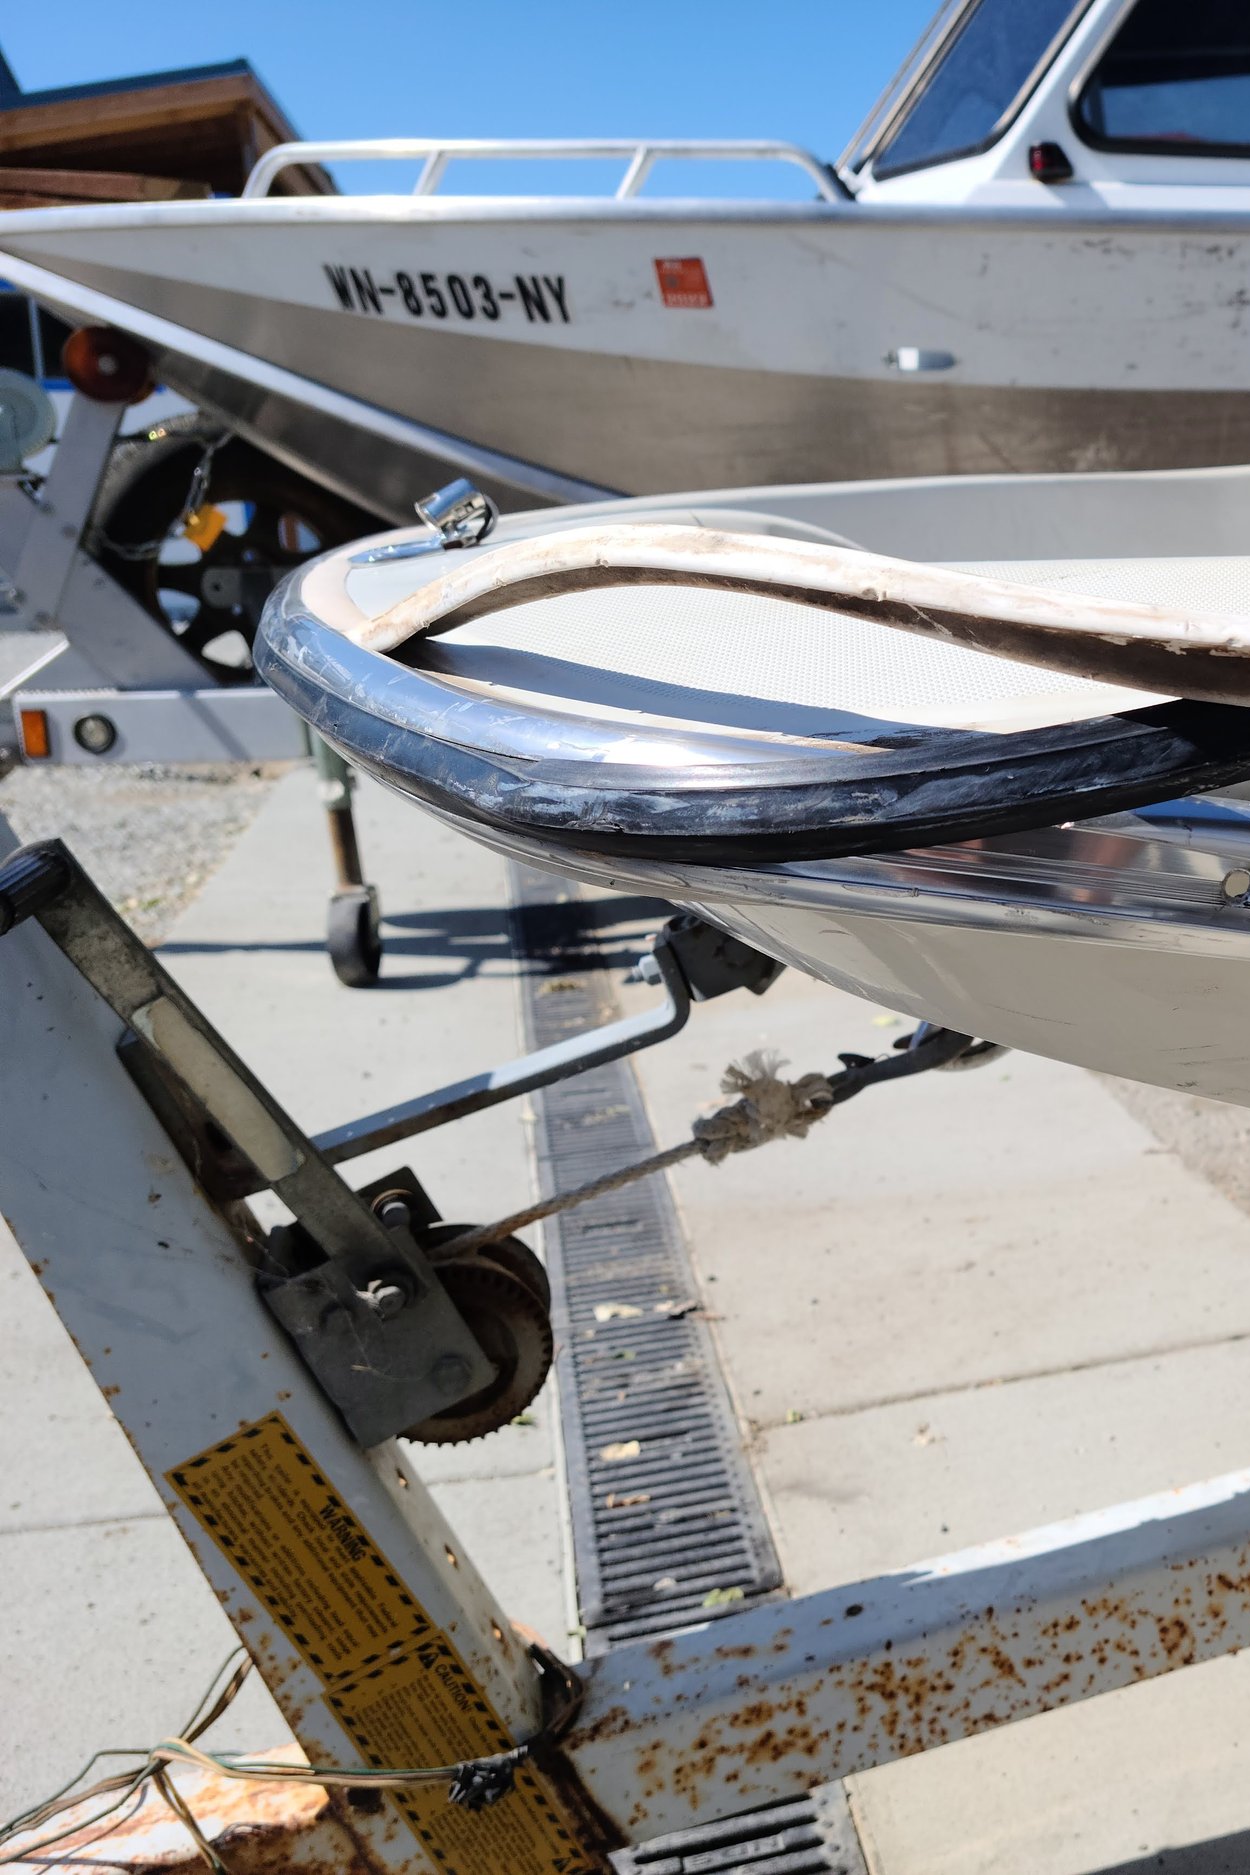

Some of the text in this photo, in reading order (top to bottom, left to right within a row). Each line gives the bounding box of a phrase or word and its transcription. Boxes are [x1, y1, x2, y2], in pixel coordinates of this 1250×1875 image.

[323, 263, 571, 325] WN-8503-NY
[316, 1502, 369, 1564] WARNING
[432, 1661, 474, 1714] CAUTION!
